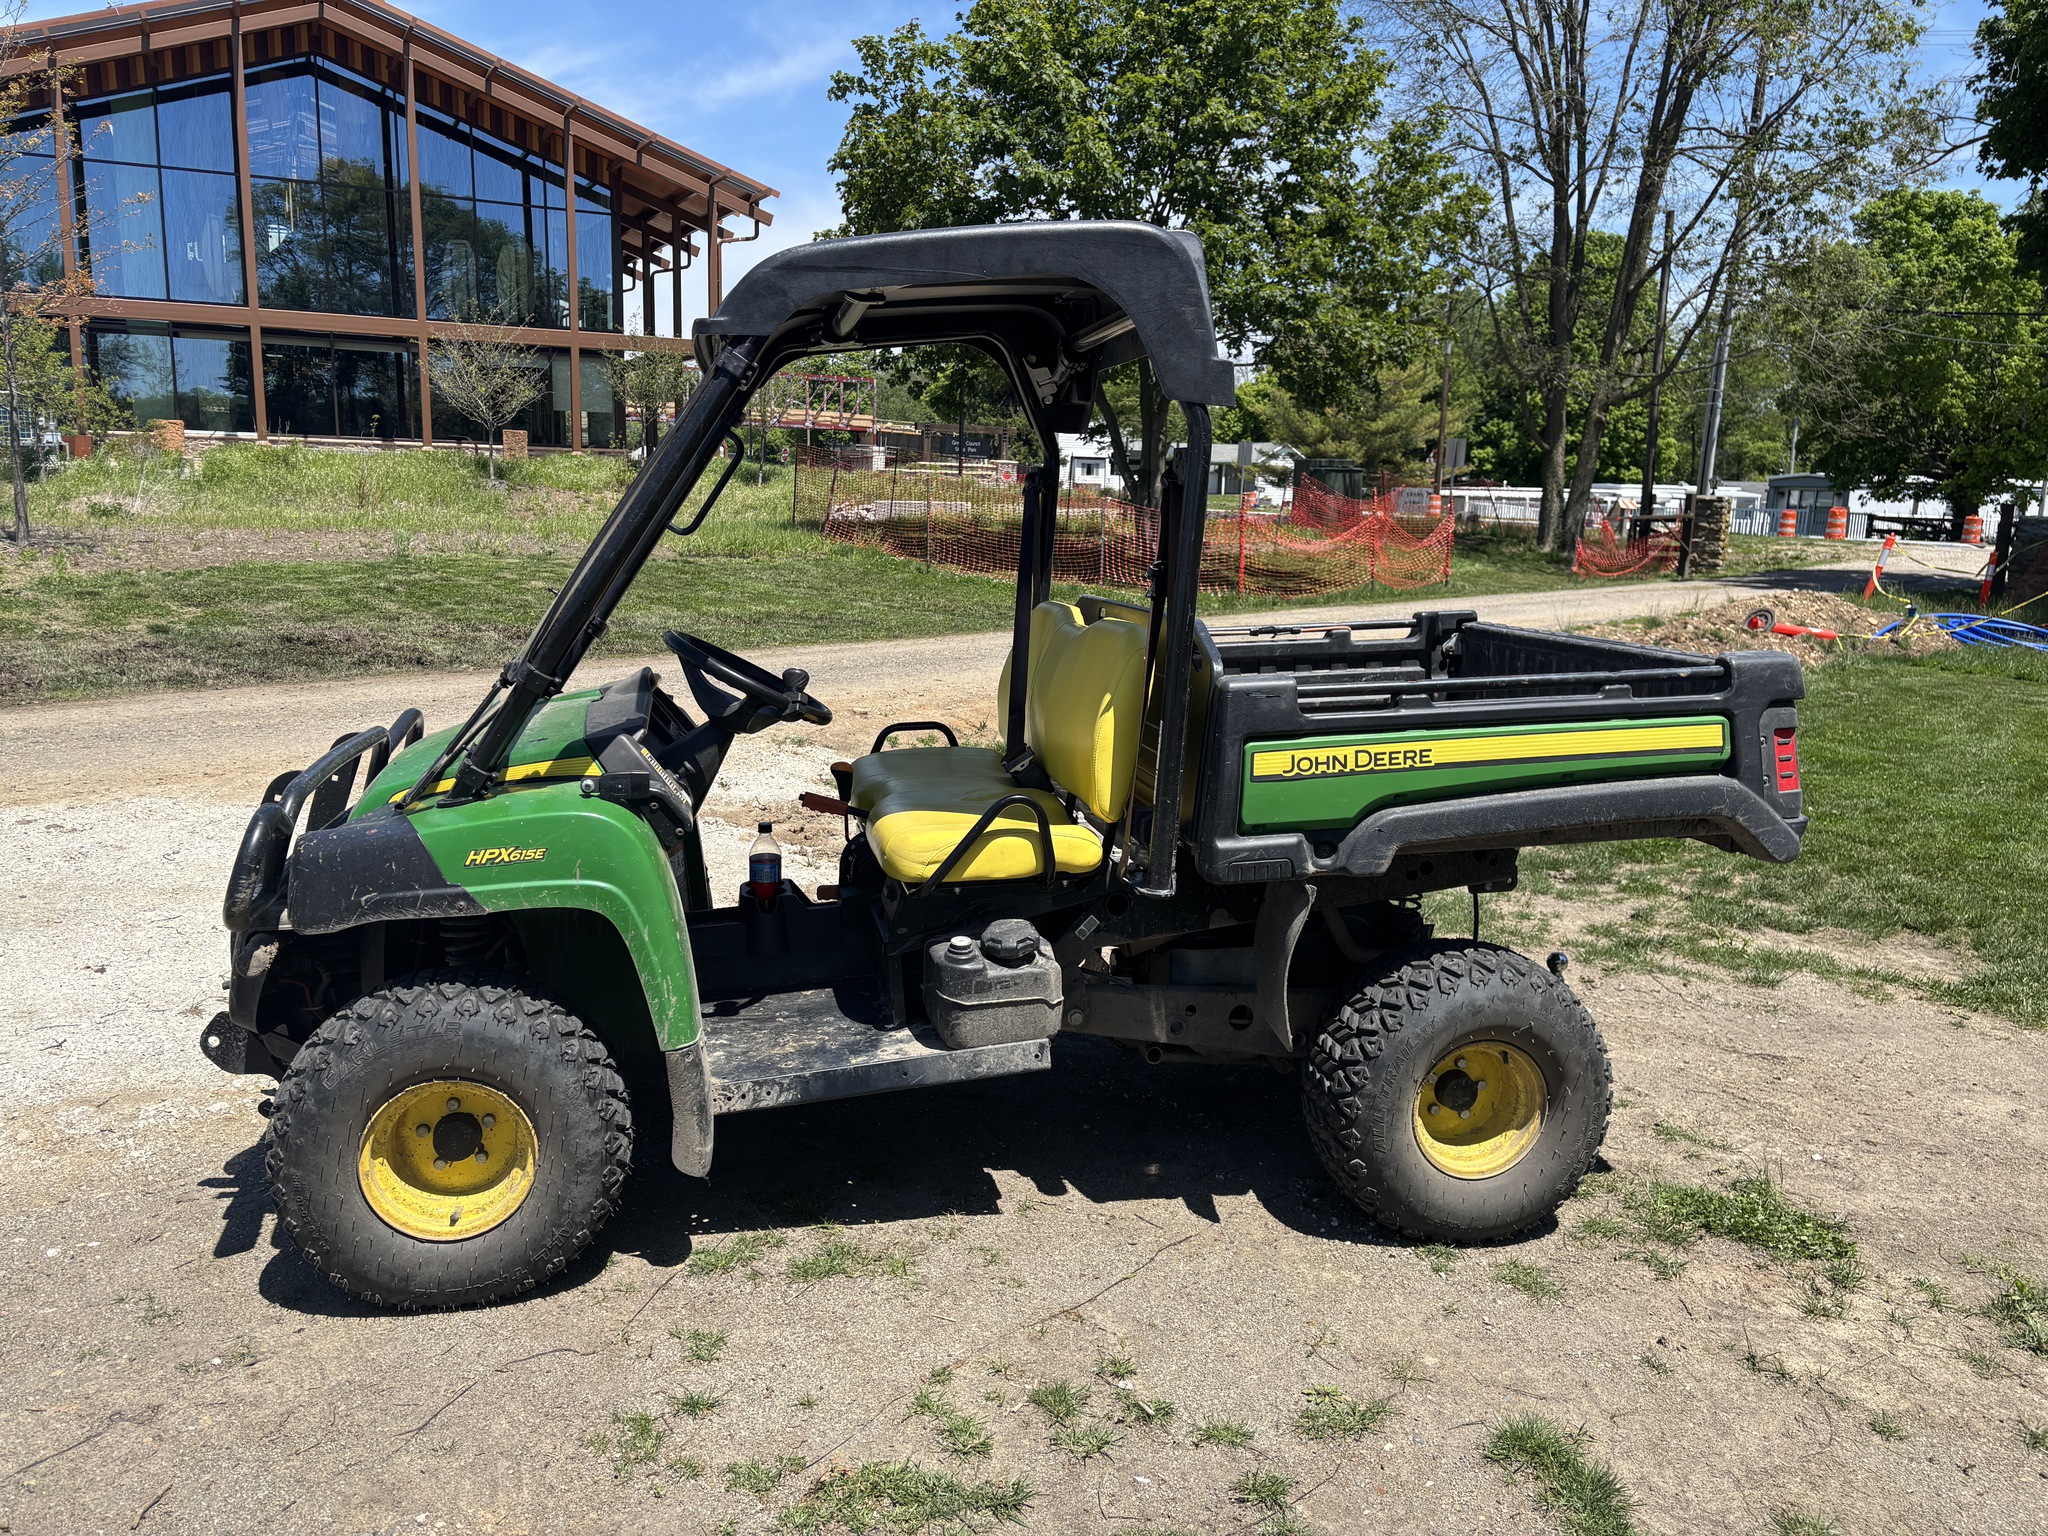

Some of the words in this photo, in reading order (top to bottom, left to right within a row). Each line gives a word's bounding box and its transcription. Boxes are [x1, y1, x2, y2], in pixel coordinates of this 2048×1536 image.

[1282, 754, 1348, 774] JOHN
[1354, 748, 1433, 769] DEERE
[464, 846, 547, 866] HPX615E
[322, 1021, 463, 1091] CARLSTAR
[1377, 1040, 1420, 1101] TRAIL
[1372, 1109, 1387, 1154] ALL
